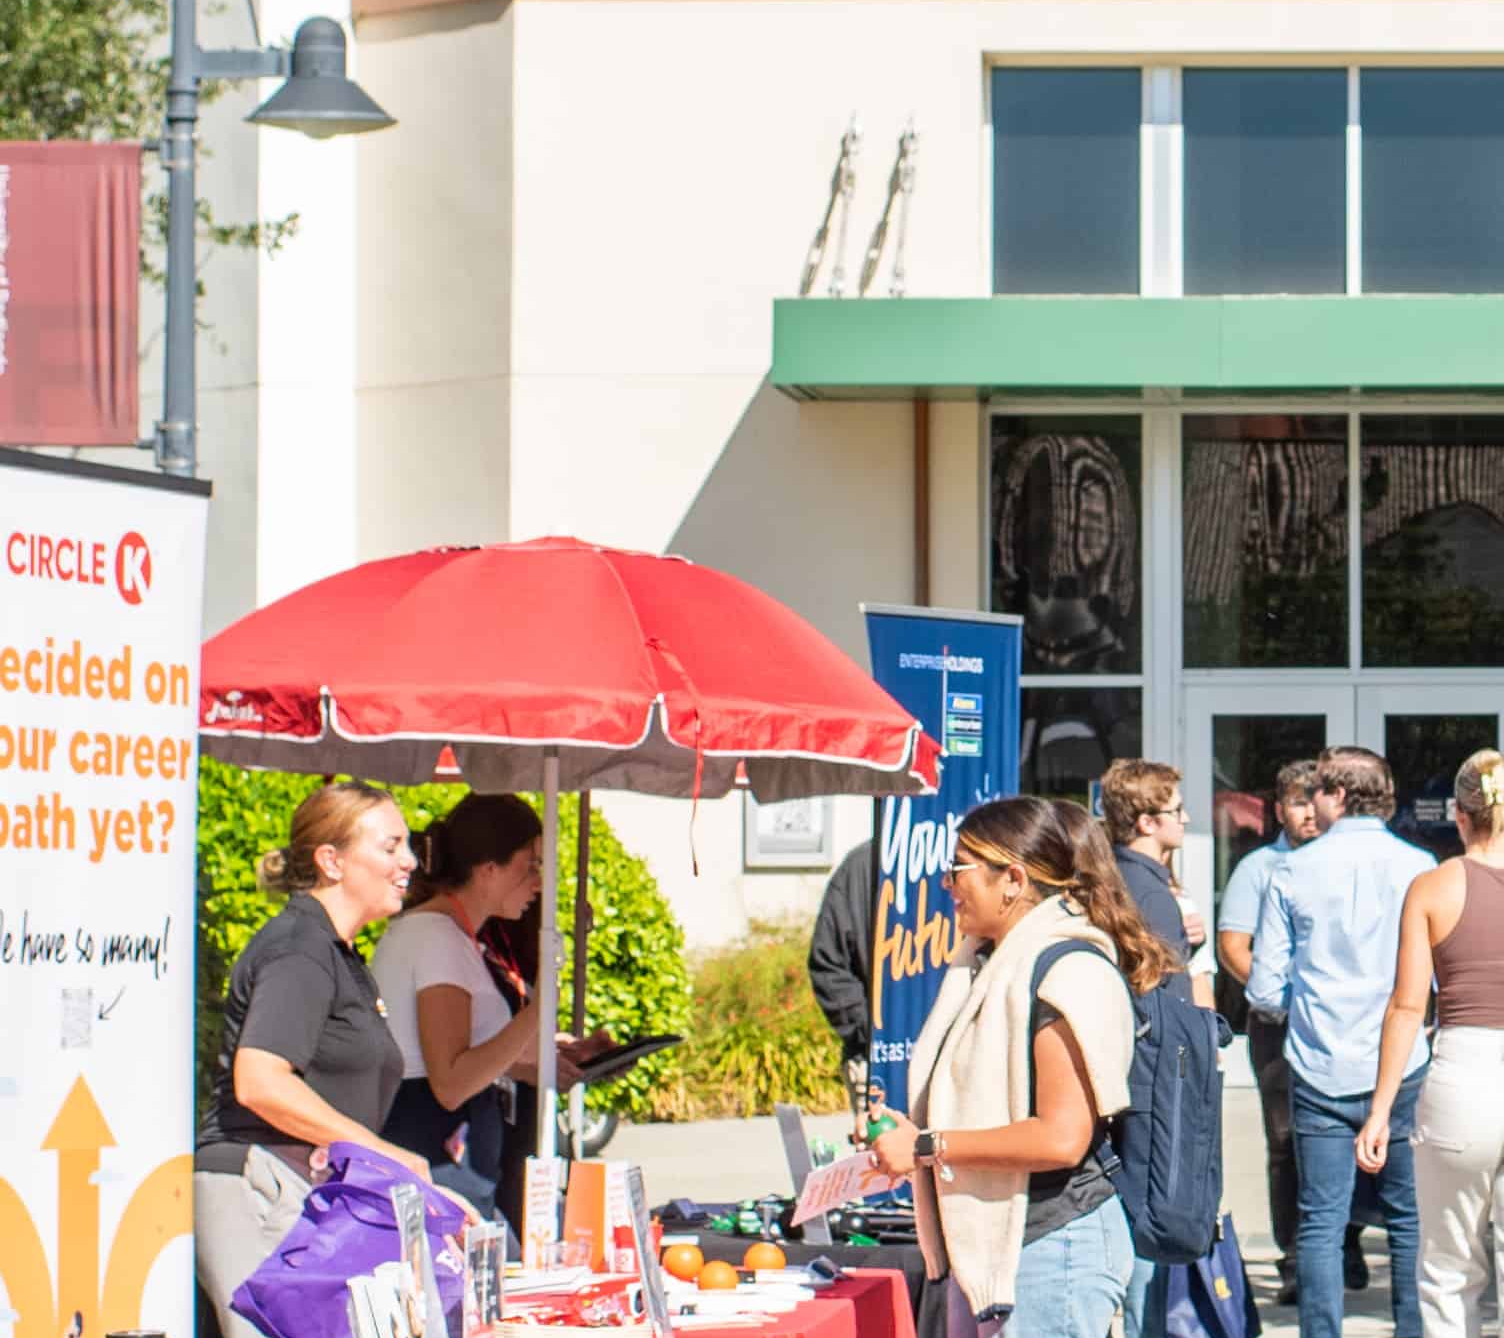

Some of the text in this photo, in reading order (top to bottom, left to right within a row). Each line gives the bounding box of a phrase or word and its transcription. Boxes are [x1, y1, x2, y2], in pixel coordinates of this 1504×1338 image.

[6, 530, 152, 605] CIRCLE K
[143, 660, 190, 707] on
[68, 727, 193, 781] career
[88, 797, 176, 864] yet?
[21, 908, 69, 967] have
[75, 926, 95, 963] so
[101, 914, 172, 980] many!
[872, 877, 962, 1031] futu
